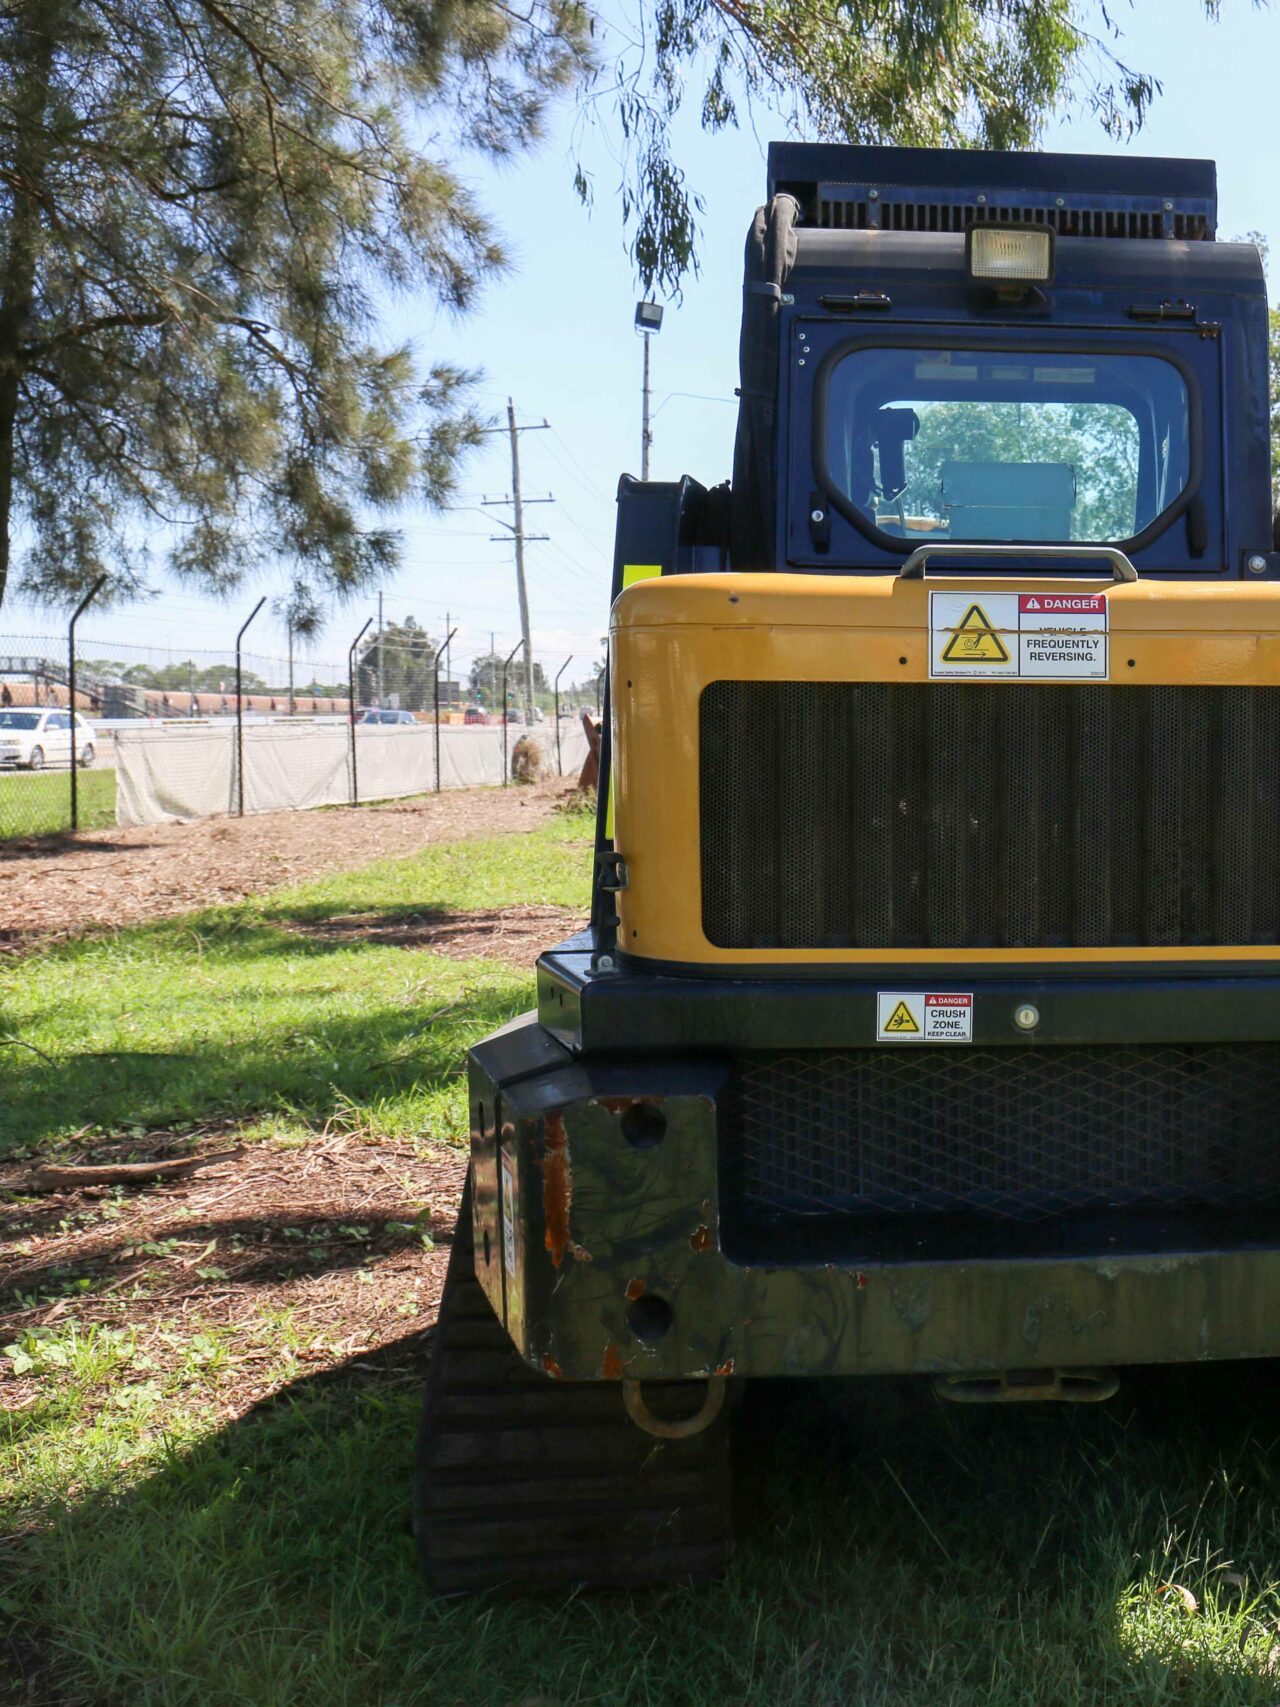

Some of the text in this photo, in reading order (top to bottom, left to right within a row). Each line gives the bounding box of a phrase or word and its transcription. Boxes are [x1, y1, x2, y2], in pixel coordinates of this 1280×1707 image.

[1044, 599, 1099, 609] DANGER
[1026, 639, 1100, 649] FREQUENTLY
[1029, 652, 1097, 662] REVERSING.
[930, 1009, 966, 1018] CRUSH
[932, 1021, 963, 1030] ZONE.
